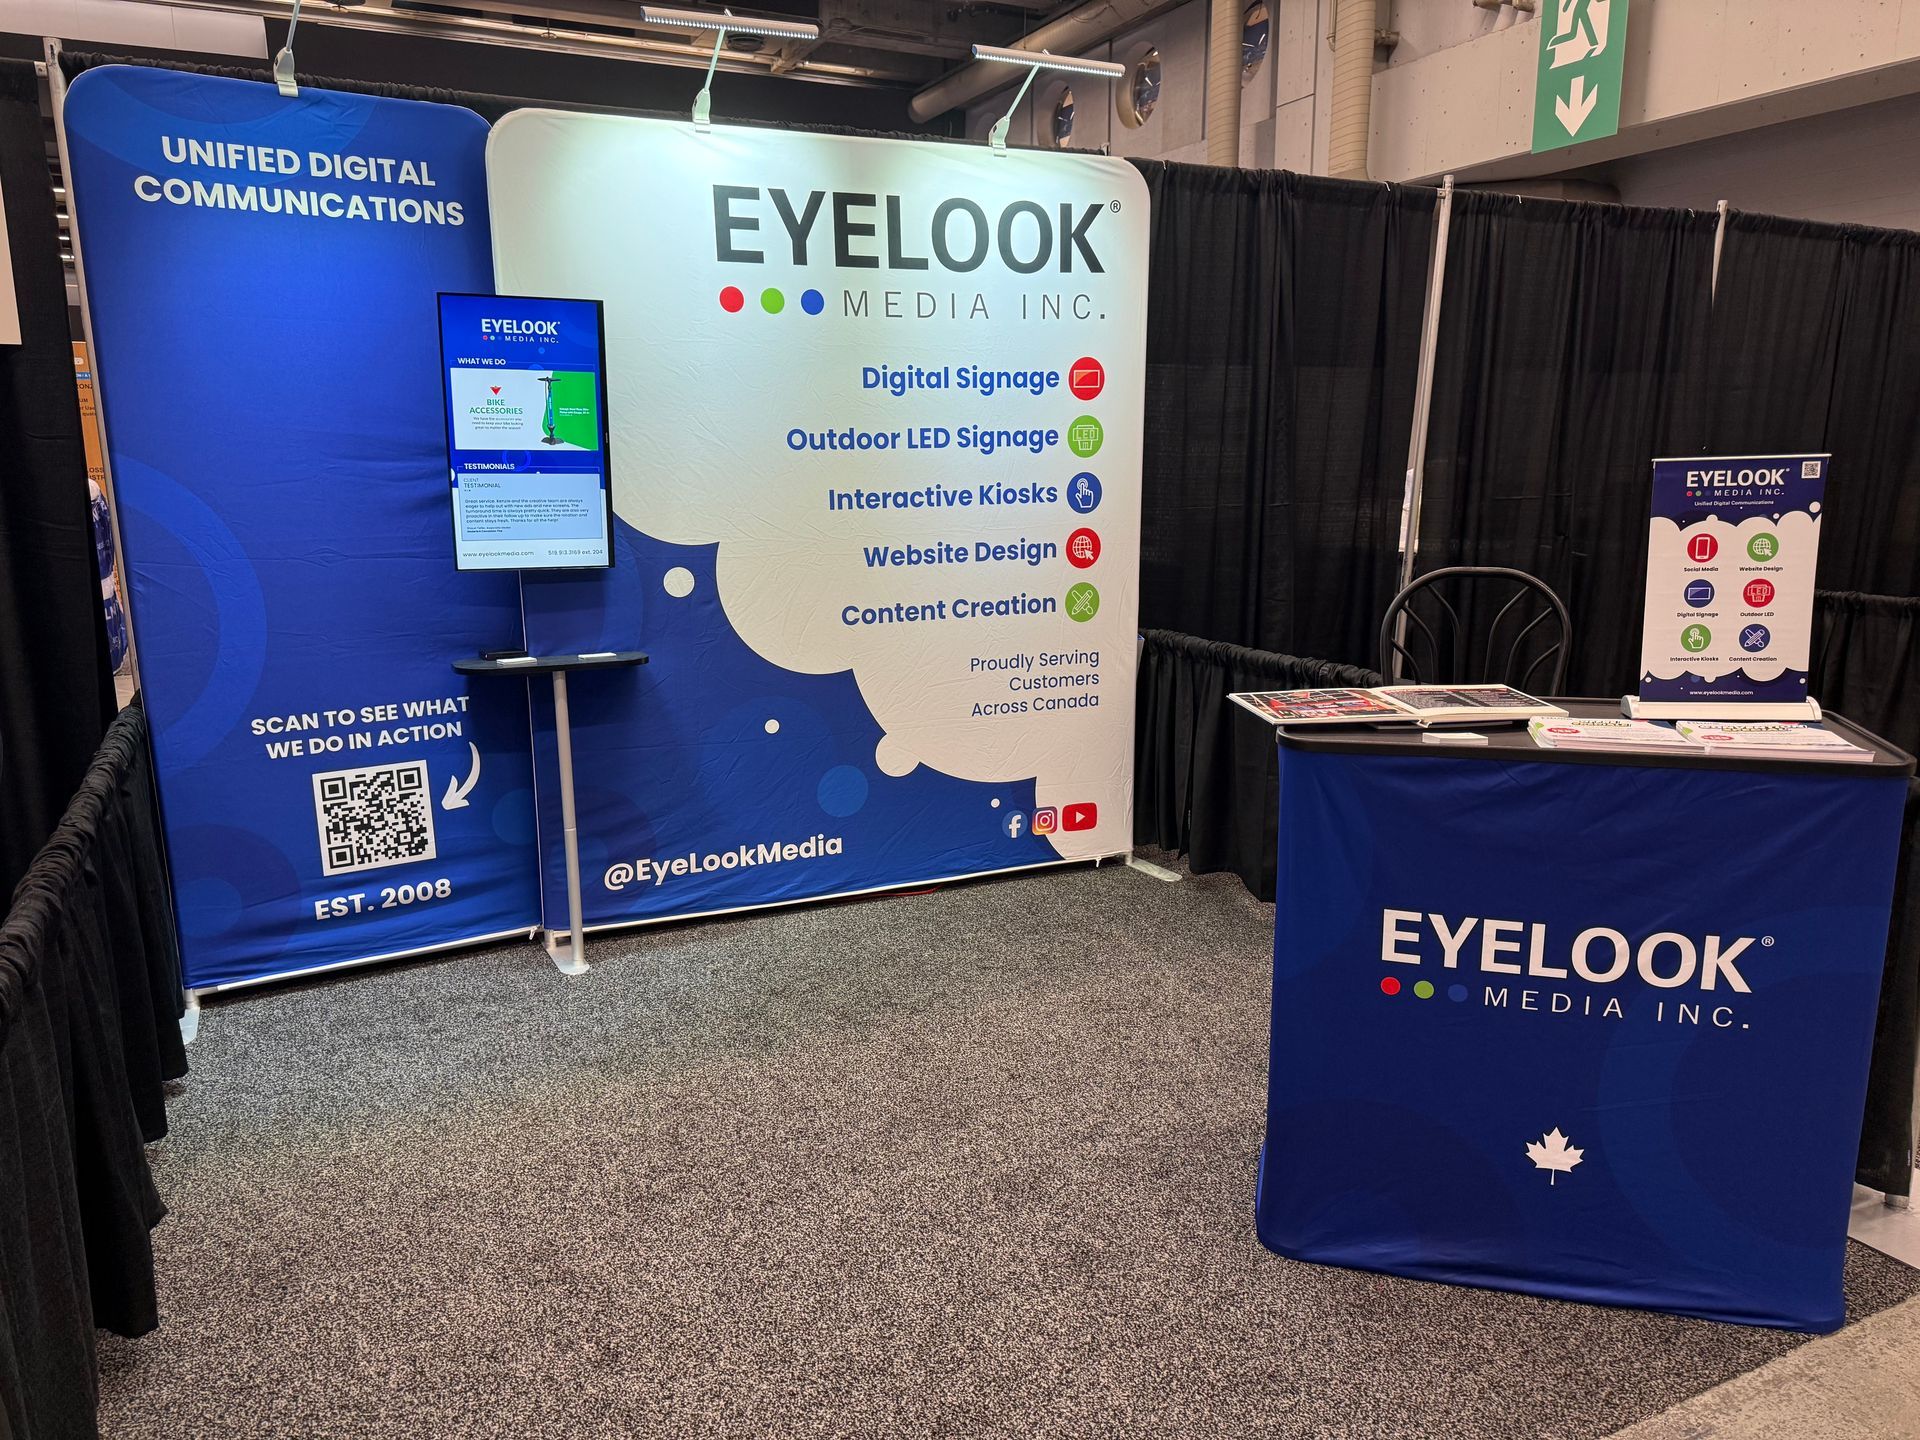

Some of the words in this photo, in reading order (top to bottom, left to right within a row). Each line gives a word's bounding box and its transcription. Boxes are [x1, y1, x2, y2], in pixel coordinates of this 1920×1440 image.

[161, 135, 301, 175] UNIFIED
[309, 151, 436, 187] DIGITAL
[133, 174, 465, 227] COMMUNICATIONS
[843, 289, 990, 320] MEDIA
[1021, 293, 1107, 320] INC.
[481, 318, 559, 335] EYELOOK
[504, 335, 535, 343] MEDIA
[539, 336, 559, 344] INC.
[457, 357, 480, 365] WHAT
[494, 358, 507, 366] DO
[862, 364, 949, 397] Digital
[956, 365, 1060, 396] Signage
[469, 407, 524, 415] ACCESSORIES
[486, 398, 505, 406] BIKE
[786, 427, 901, 451] Outdoor
[906, 427, 951, 450] LED
[957, 424, 1059, 455] Signage
[463, 462, 515, 470] TESTIMONIALS
[1686, 468, 1785, 487] EYELOOK
[828, 484, 973, 511] Interactive
[979, 482, 1058, 506] Kiosks
[1714, 489, 1752, 497] MEDIA
[1759, 488, 1785, 496] INC.
[863, 541, 969, 568] Website
[975, 537, 1057, 566] Design
[841, 600, 947, 626] Content
[951, 592, 1057, 619] Creation
[970, 653, 1035, 673] Proudly
[1039, 649, 1100, 668] Serving
[1009, 672, 1100, 691] Customers
[250, 712, 319, 736] SCAN
[323, 709, 356, 727] TO
[360, 704, 399, 723] SEE
[402, 695, 470, 719] WHAT
[971, 698, 1028, 717] Across
[1033, 693, 1100, 711] Canada
[265, 741, 304, 760] WE
[308, 735, 344, 755] DO
[348, 731, 372, 750] IN
[377, 721, 463, 747] ACTION
[603, 833, 844, 891] @EyeLookMedia
[314, 893, 375, 921] EST.
[380, 878, 452, 909] 2008
[1483, 985, 1624, 1019] MEDIA
[1656, 1001, 1750, 1030] INC.
